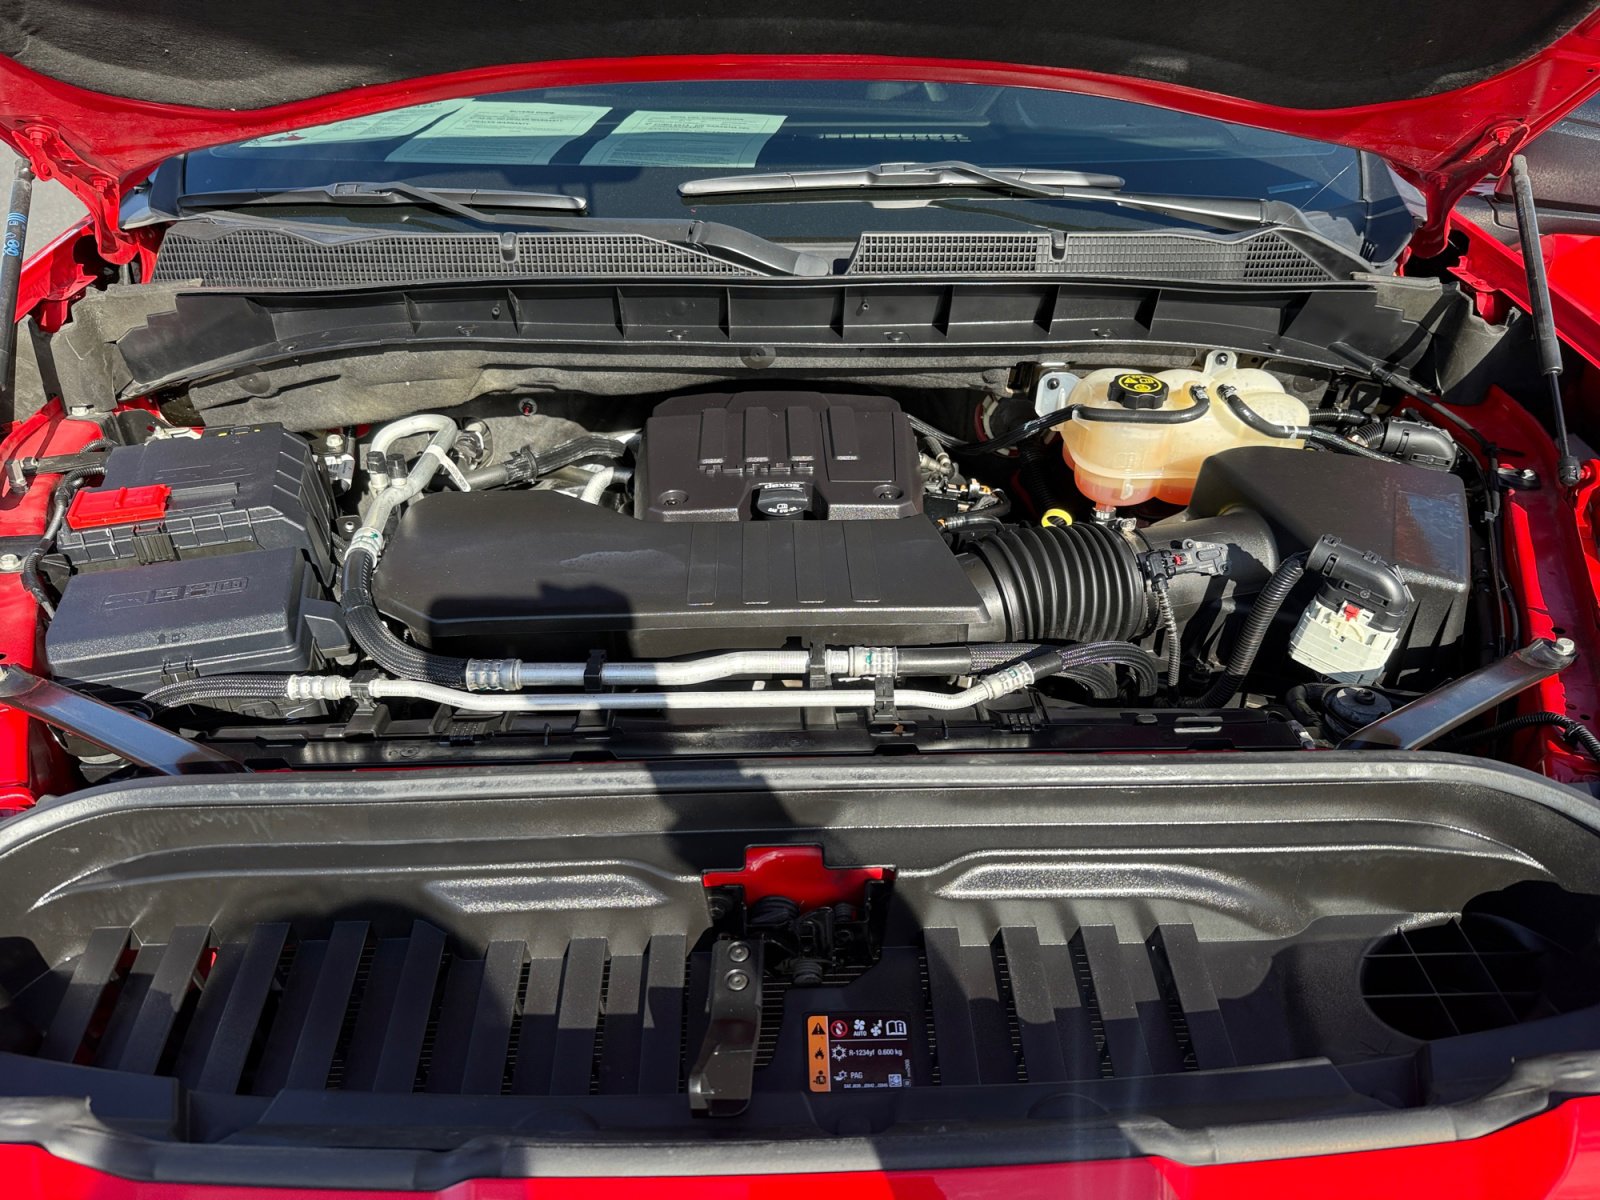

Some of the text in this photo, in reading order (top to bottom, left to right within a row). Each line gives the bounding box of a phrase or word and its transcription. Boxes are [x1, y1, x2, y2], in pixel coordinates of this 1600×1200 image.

[848, 1049, 875, 1057] R-1234yf
[894, 1048, 903, 1057] kg
[850, 1071, 863, 1079] PAG
